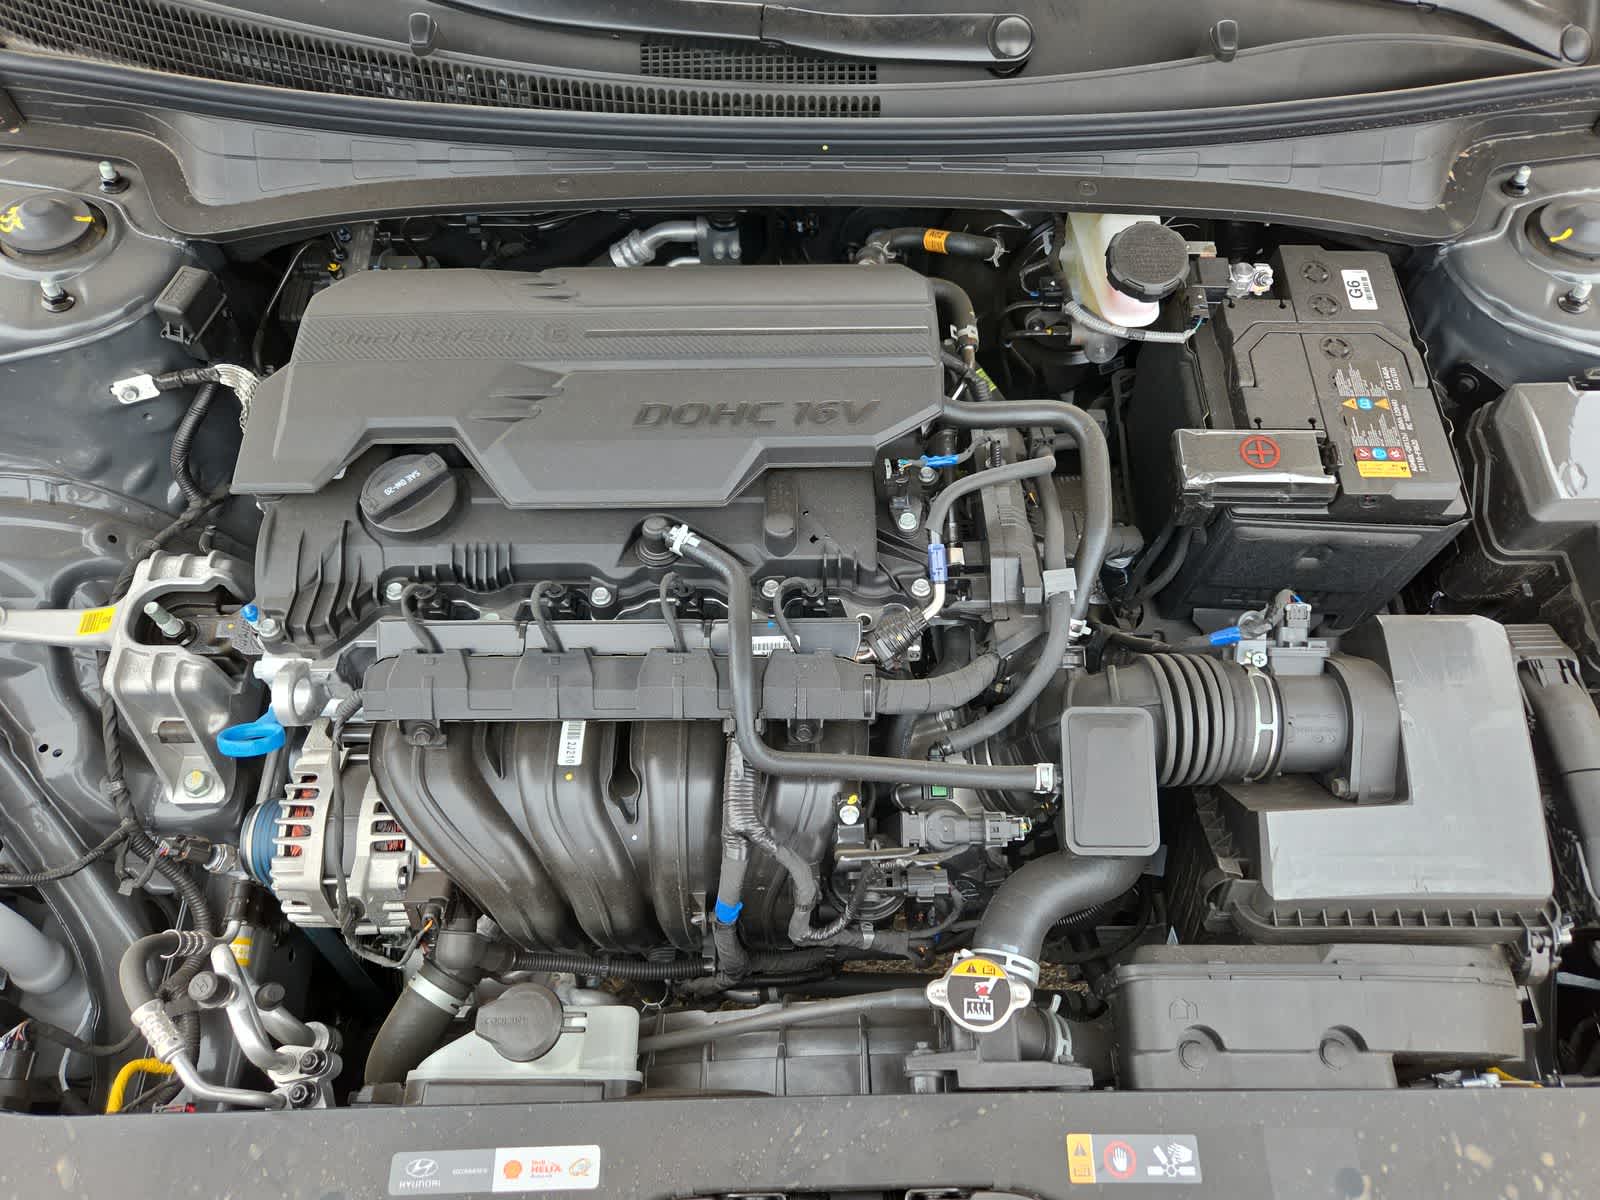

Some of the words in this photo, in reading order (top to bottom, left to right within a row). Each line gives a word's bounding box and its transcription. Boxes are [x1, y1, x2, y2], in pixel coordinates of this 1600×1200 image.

[1346, 280, 1363, 299] G6
[632, 400, 784, 427] DOHC
[793, 399, 880, 427] 16V
[399, 1178, 441, 1190] HYUNDAI
